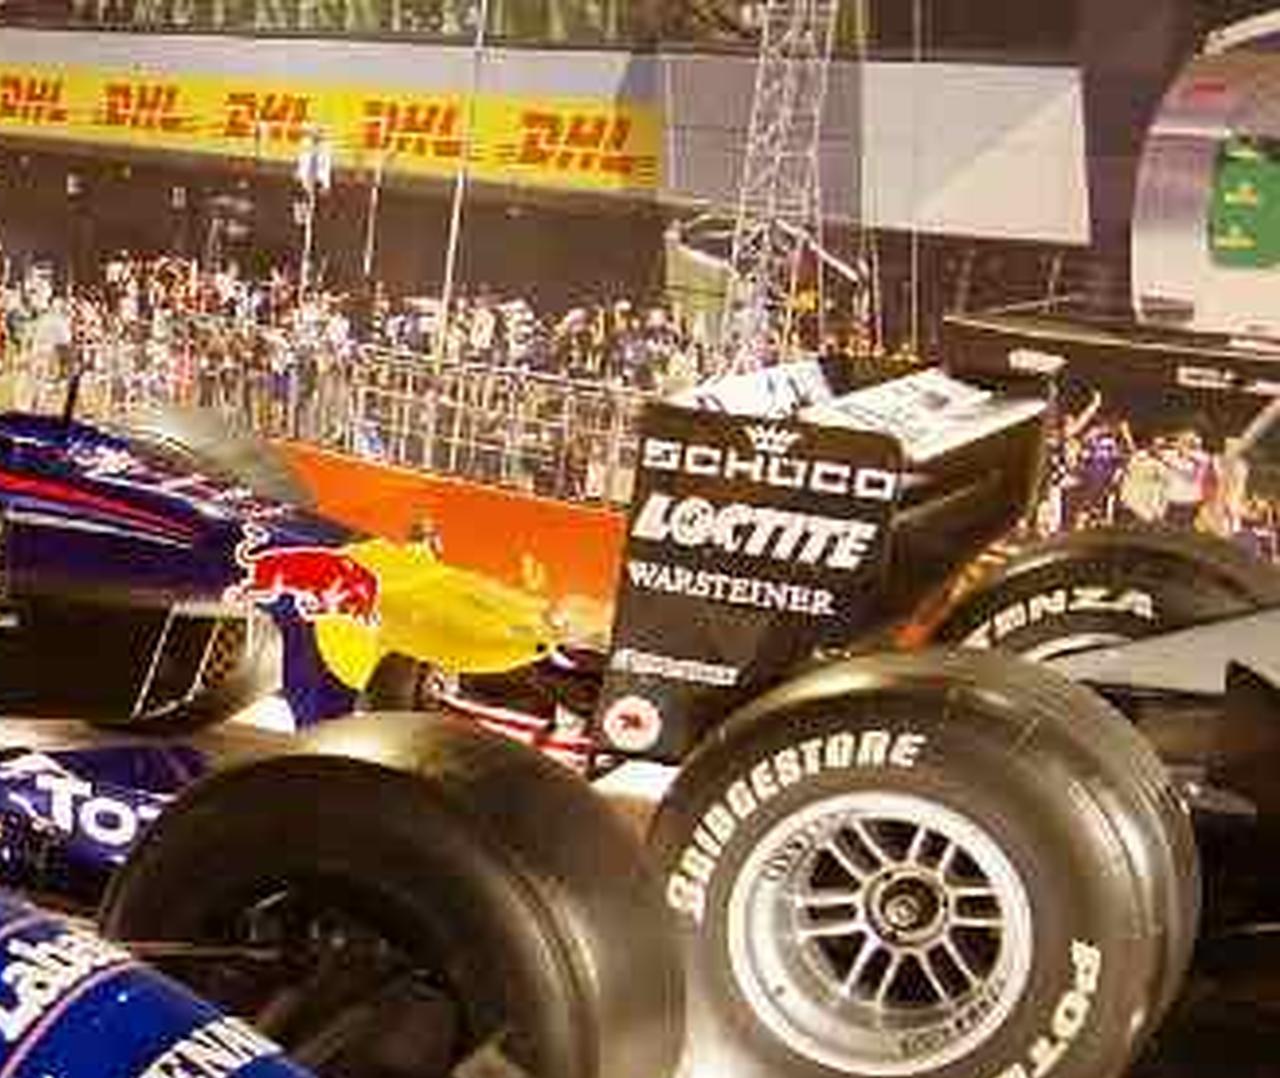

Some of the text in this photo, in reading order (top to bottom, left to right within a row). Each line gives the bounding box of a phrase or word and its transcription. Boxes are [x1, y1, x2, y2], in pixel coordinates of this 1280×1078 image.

[520, 110, 638, 176] DHL
[630, 494, 878, 570] LOCTITE
[627, 560, 836, 616] WARSTEINER
[666, 731, 928, 926] BRIDGESTONE
